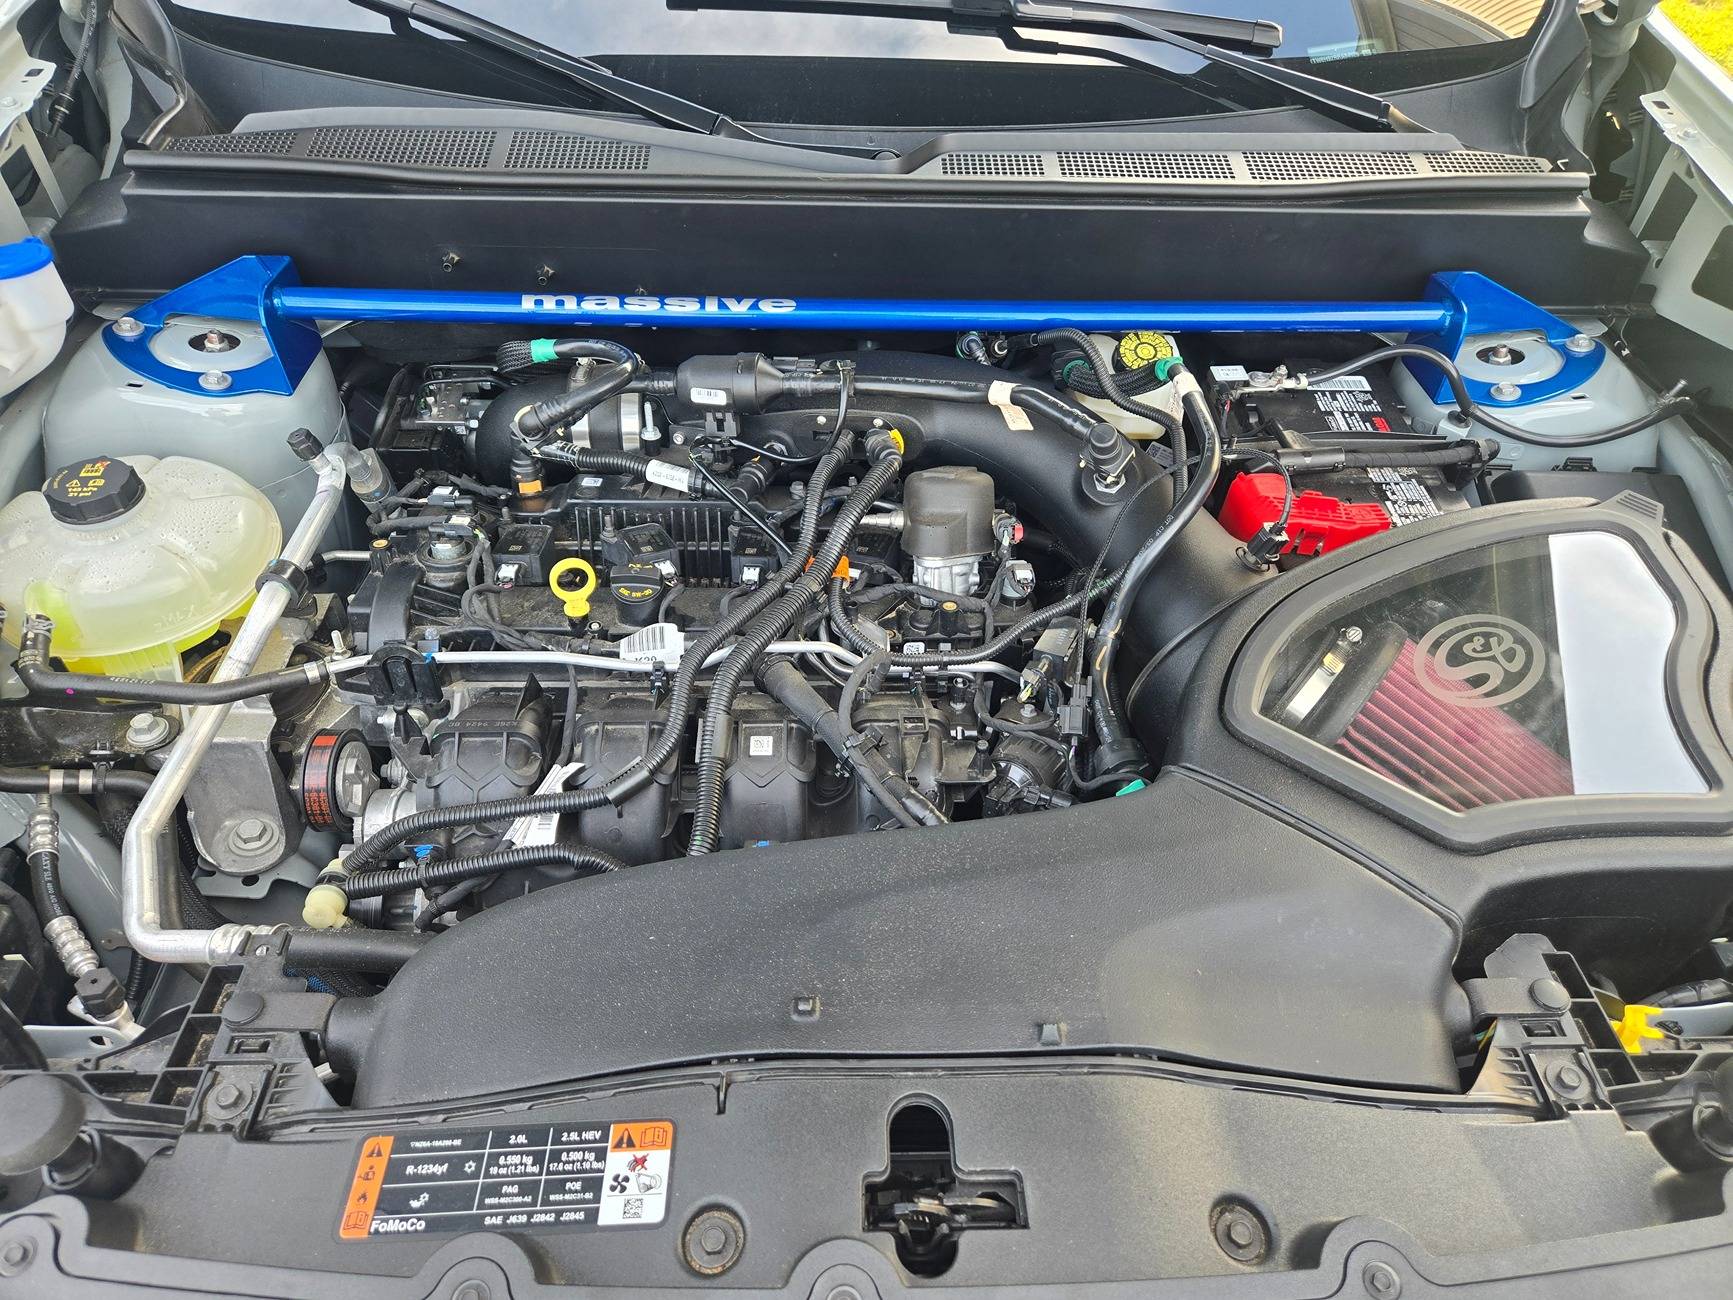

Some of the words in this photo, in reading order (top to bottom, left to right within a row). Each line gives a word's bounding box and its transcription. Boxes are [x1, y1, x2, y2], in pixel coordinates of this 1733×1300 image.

[521, 294, 797, 312] massive
[508, 1134, 528, 1144] 2.0L
[561, 1132, 580, 1142] 2.5L
[581, 1130, 602, 1140] HEV
[498, 1155, 522, 1165] 0.550
[522, 1154, 533, 1164] kg
[561, 1152, 584, 1162] 0.500
[584, 1150, 596, 1161] kg
[406, 1163, 448, 1176] R-1234yf
[501, 1185, 519, 1194] PAG
[565, 1182, 582, 1190] POE
[484, 1216, 503, 1225] SAE
[506, 1215, 528, 1224] J639
[560, 1212, 585, 1221] J2845
[370, 1218, 426, 1233] FoMoCo
